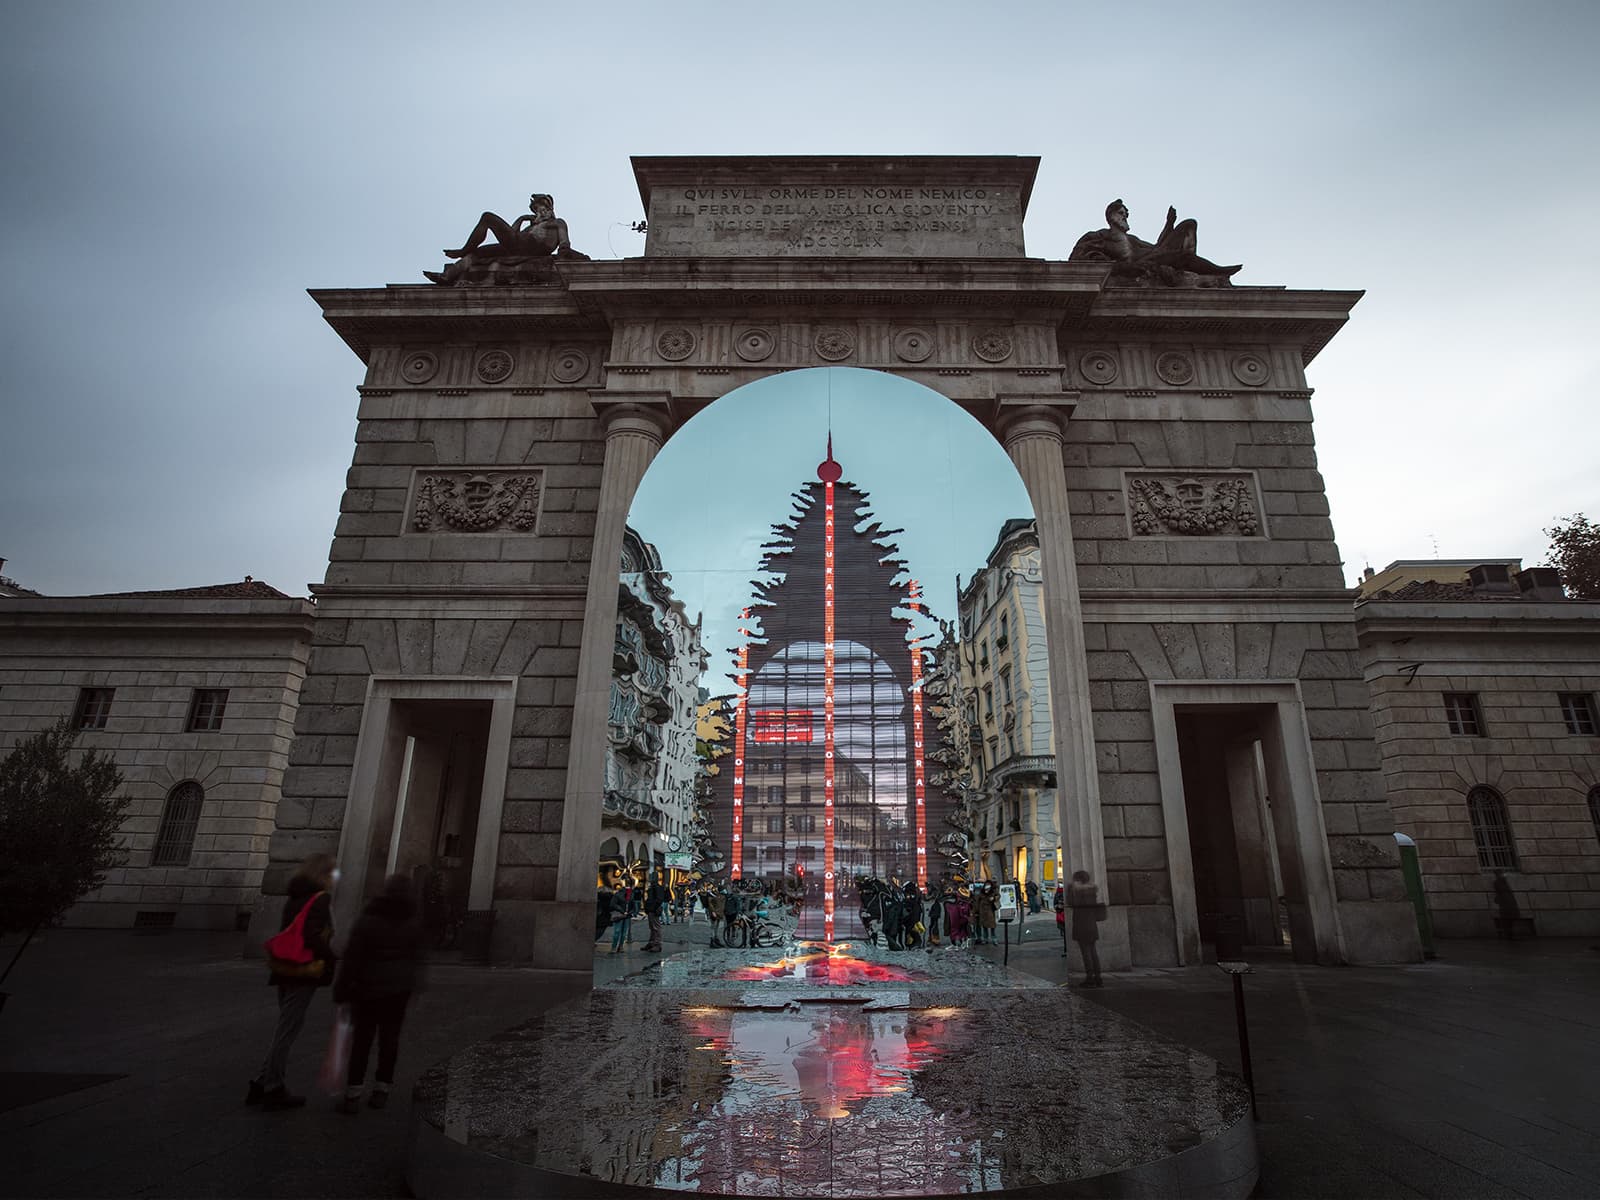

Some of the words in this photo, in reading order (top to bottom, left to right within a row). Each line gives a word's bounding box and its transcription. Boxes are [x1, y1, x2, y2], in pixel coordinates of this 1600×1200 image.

[675, 204, 695, 215] IL
[698, 204, 756, 215] FERRO
[762, 204, 819, 215] DELLA
[827, 204, 897, 215] ITALICA
[684, 188, 715, 201] QVI
[769, 188, 819, 199] ORME
[824, 188, 856, 199] DEL
[863, 188, 913, 199] NOME
[920, 188, 987, 199] NEMICO
[825, 504, 834, 607] NATURAE
[825, 625, 834, 760] IMITATIO
[825, 779, 834, 827] EST
